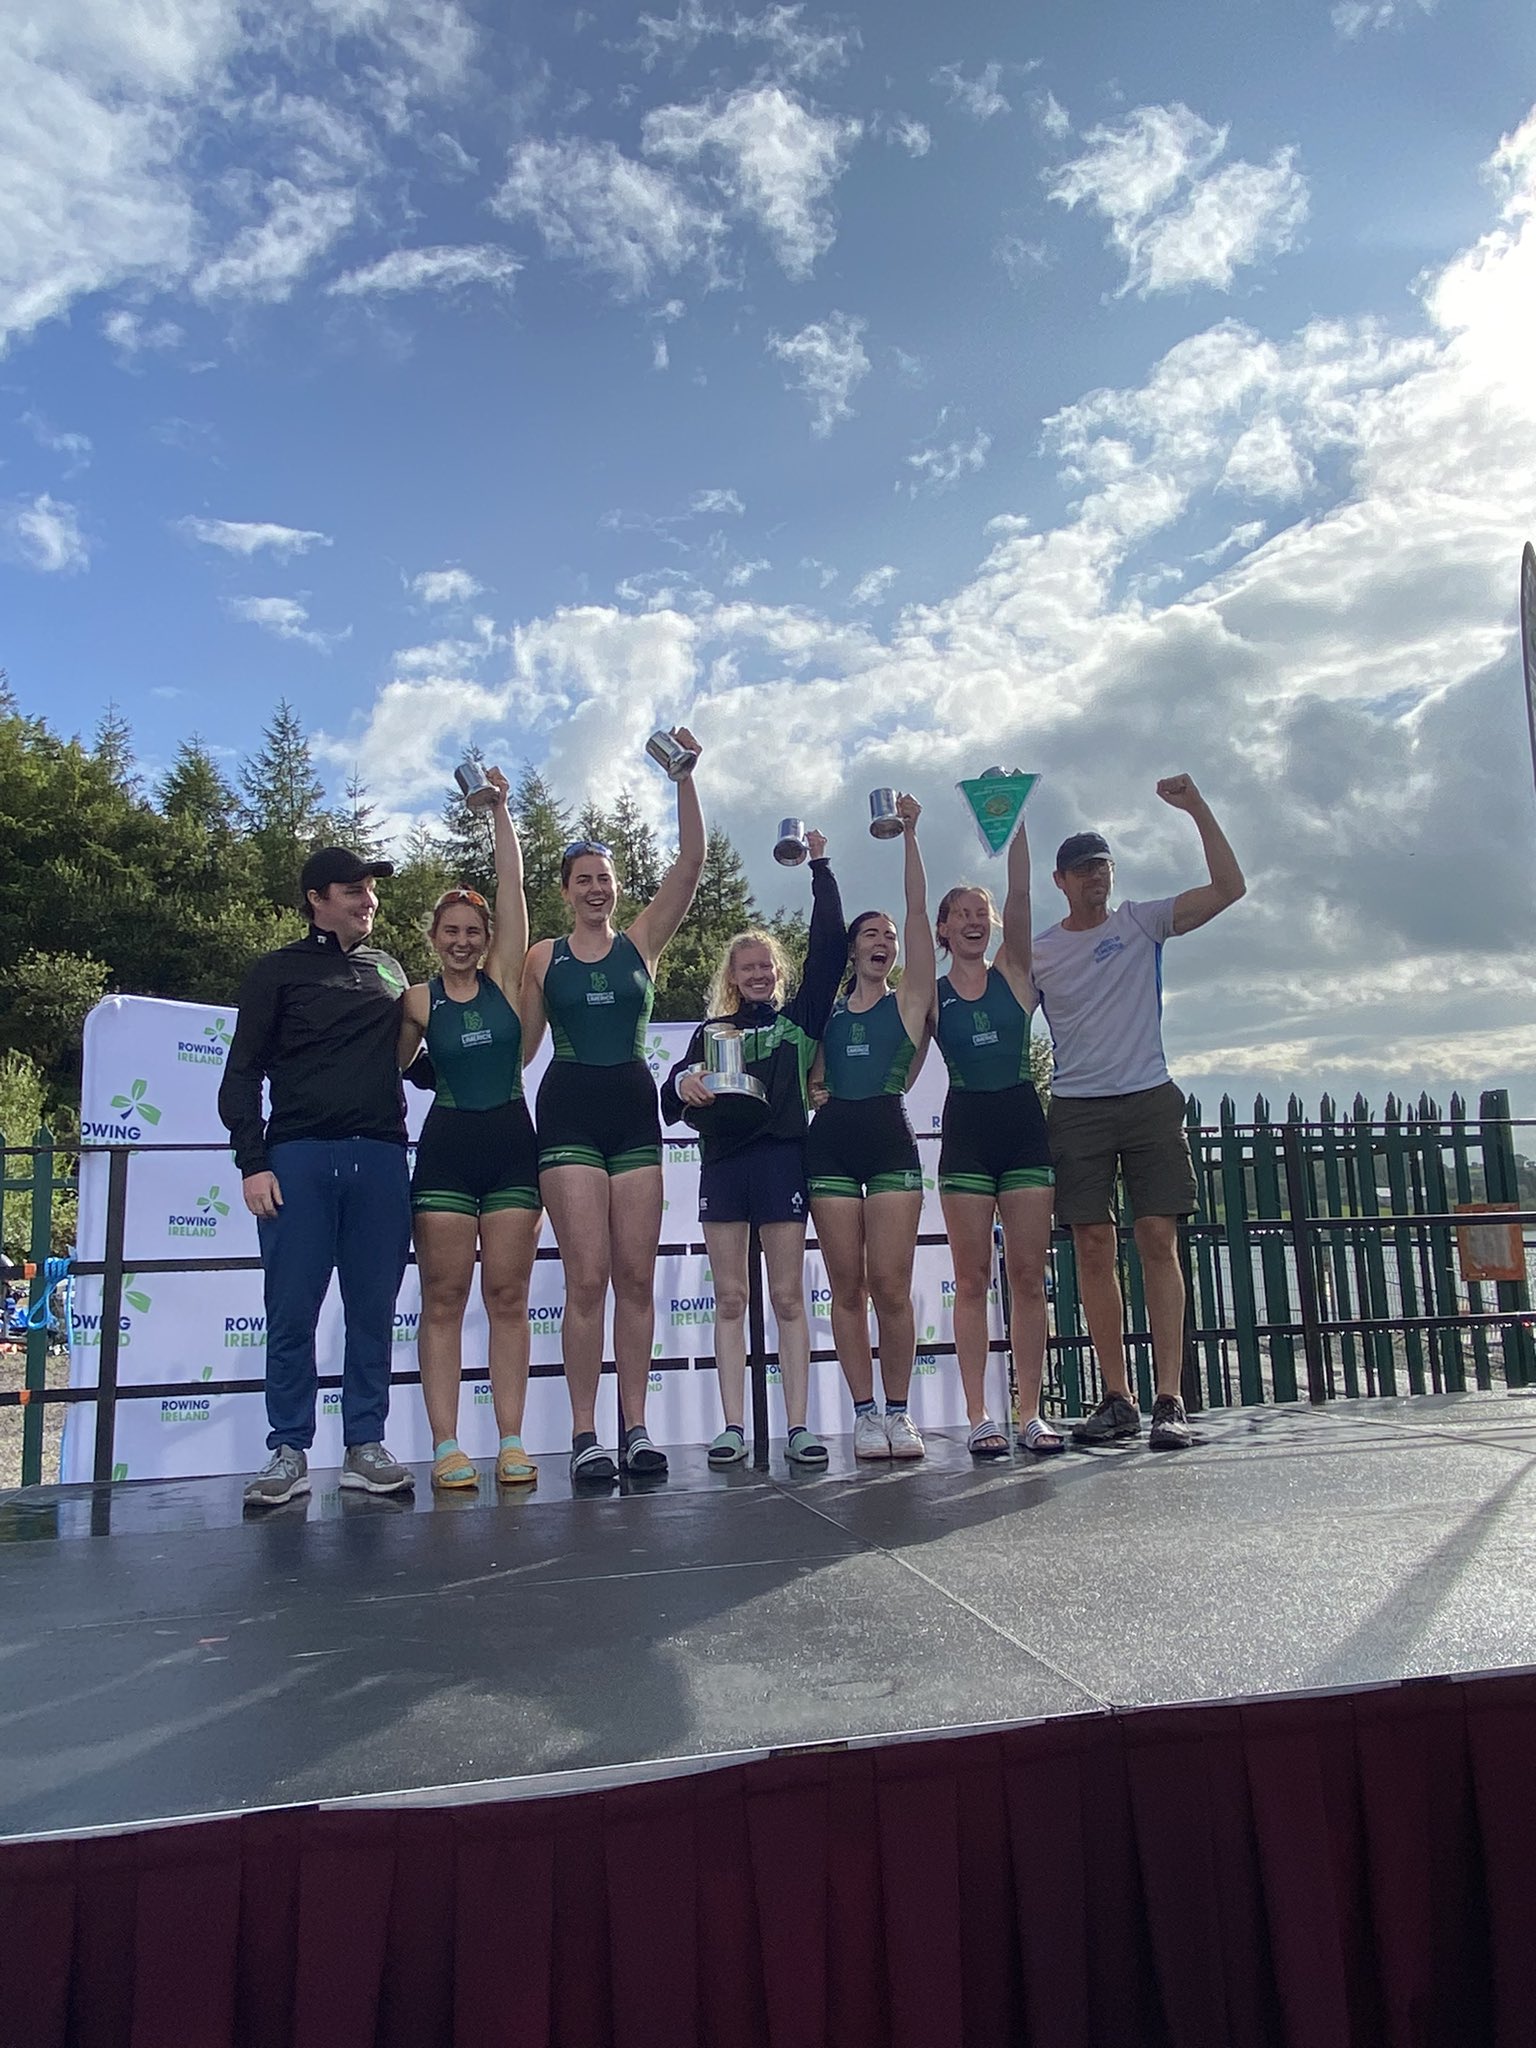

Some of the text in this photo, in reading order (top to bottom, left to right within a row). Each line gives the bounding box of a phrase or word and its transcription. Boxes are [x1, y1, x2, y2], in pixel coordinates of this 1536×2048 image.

[178, 1041, 223, 1056] ROWING
[177, 1051, 223, 1066] IRELAND
[82, 1121, 141, 1140] OWING
[669, 1150, 699, 1163] IREL
[169, 1215, 217, 1227] ROWING
[168, 1226, 217, 1237] IRELAND
[528, 1306, 563, 1320] ROW
[671, 1311, 716, 1326] IRELA
[225, 1317, 265, 1331] ROW
[224, 1332, 267, 1347] IRELA
[161, 1399, 210, 1411] ROWING
[161, 1410, 210, 1422] IRELAND
